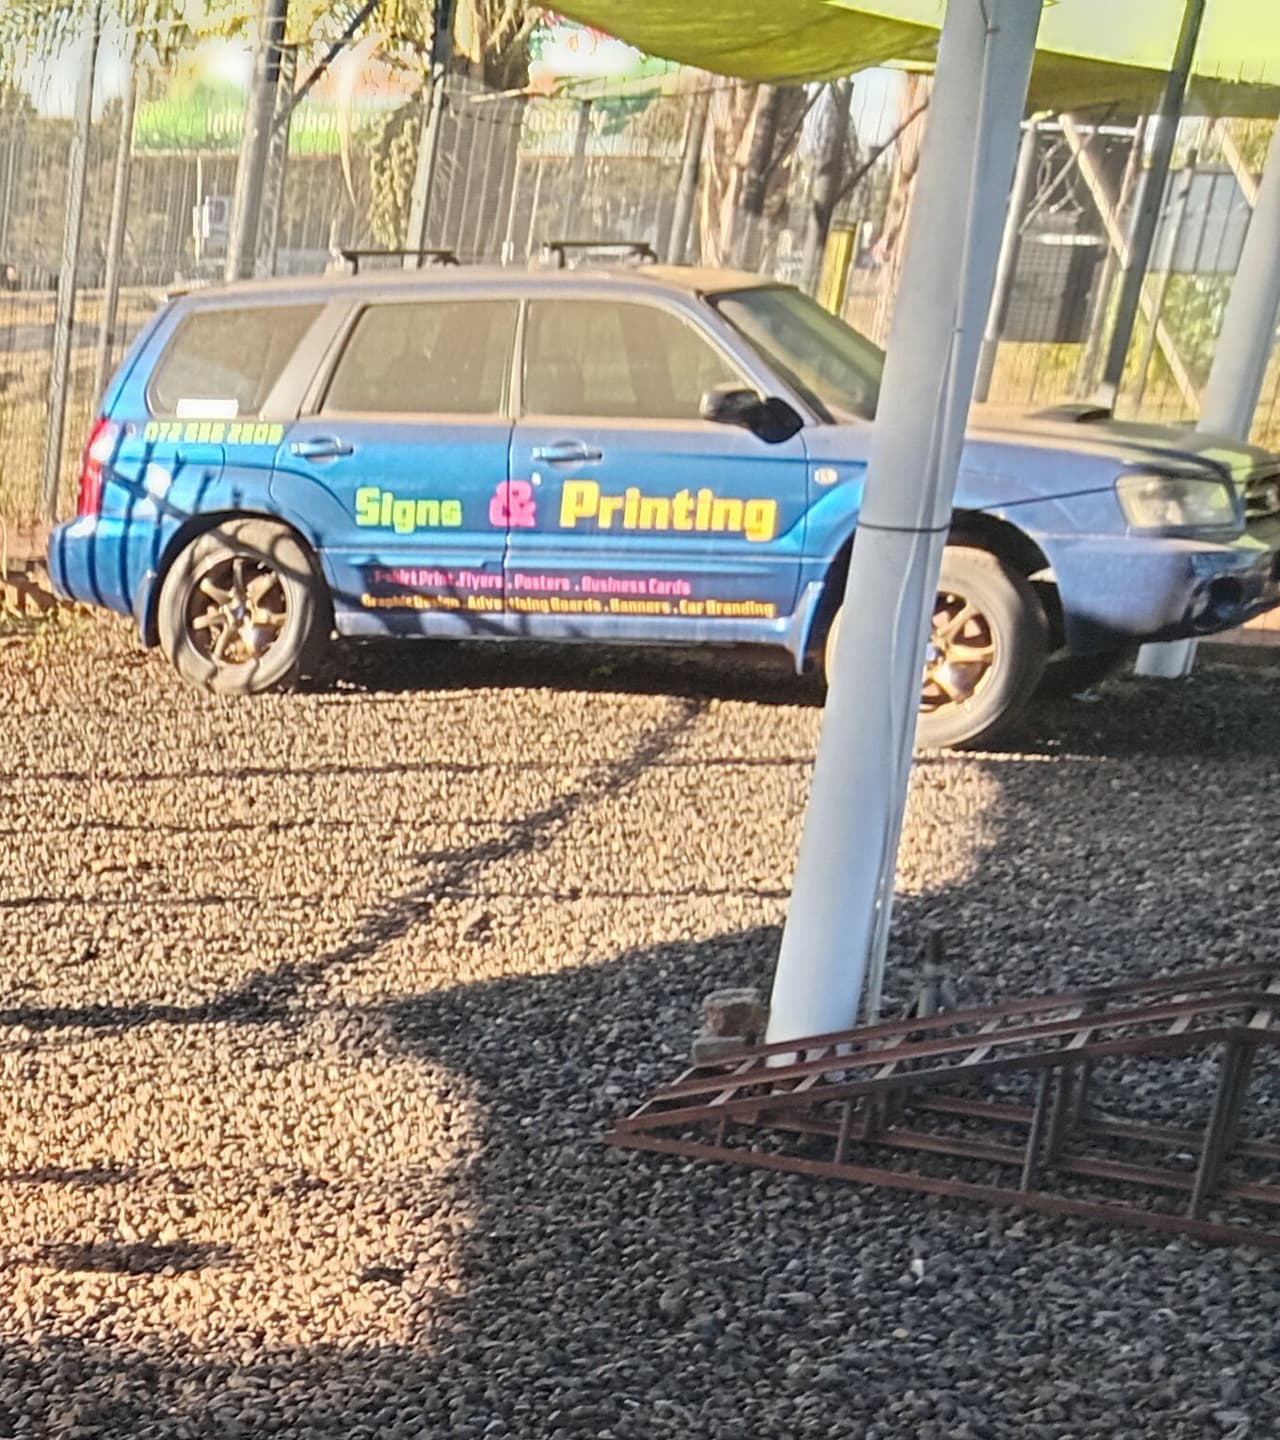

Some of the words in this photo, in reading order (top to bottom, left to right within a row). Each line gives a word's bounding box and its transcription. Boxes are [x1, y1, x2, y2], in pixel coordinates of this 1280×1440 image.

[355, 487, 462, 534] Signs
[489, 480, 536, 528] &
[559, 480, 778, 542] Printing
[514, 573, 570, 591] Posters
[581, 576, 647, 594] Business
[648, 578, 691, 595] Cards
[609, 598, 671, 614] Banners
[706, 600, 776, 618] Branding
